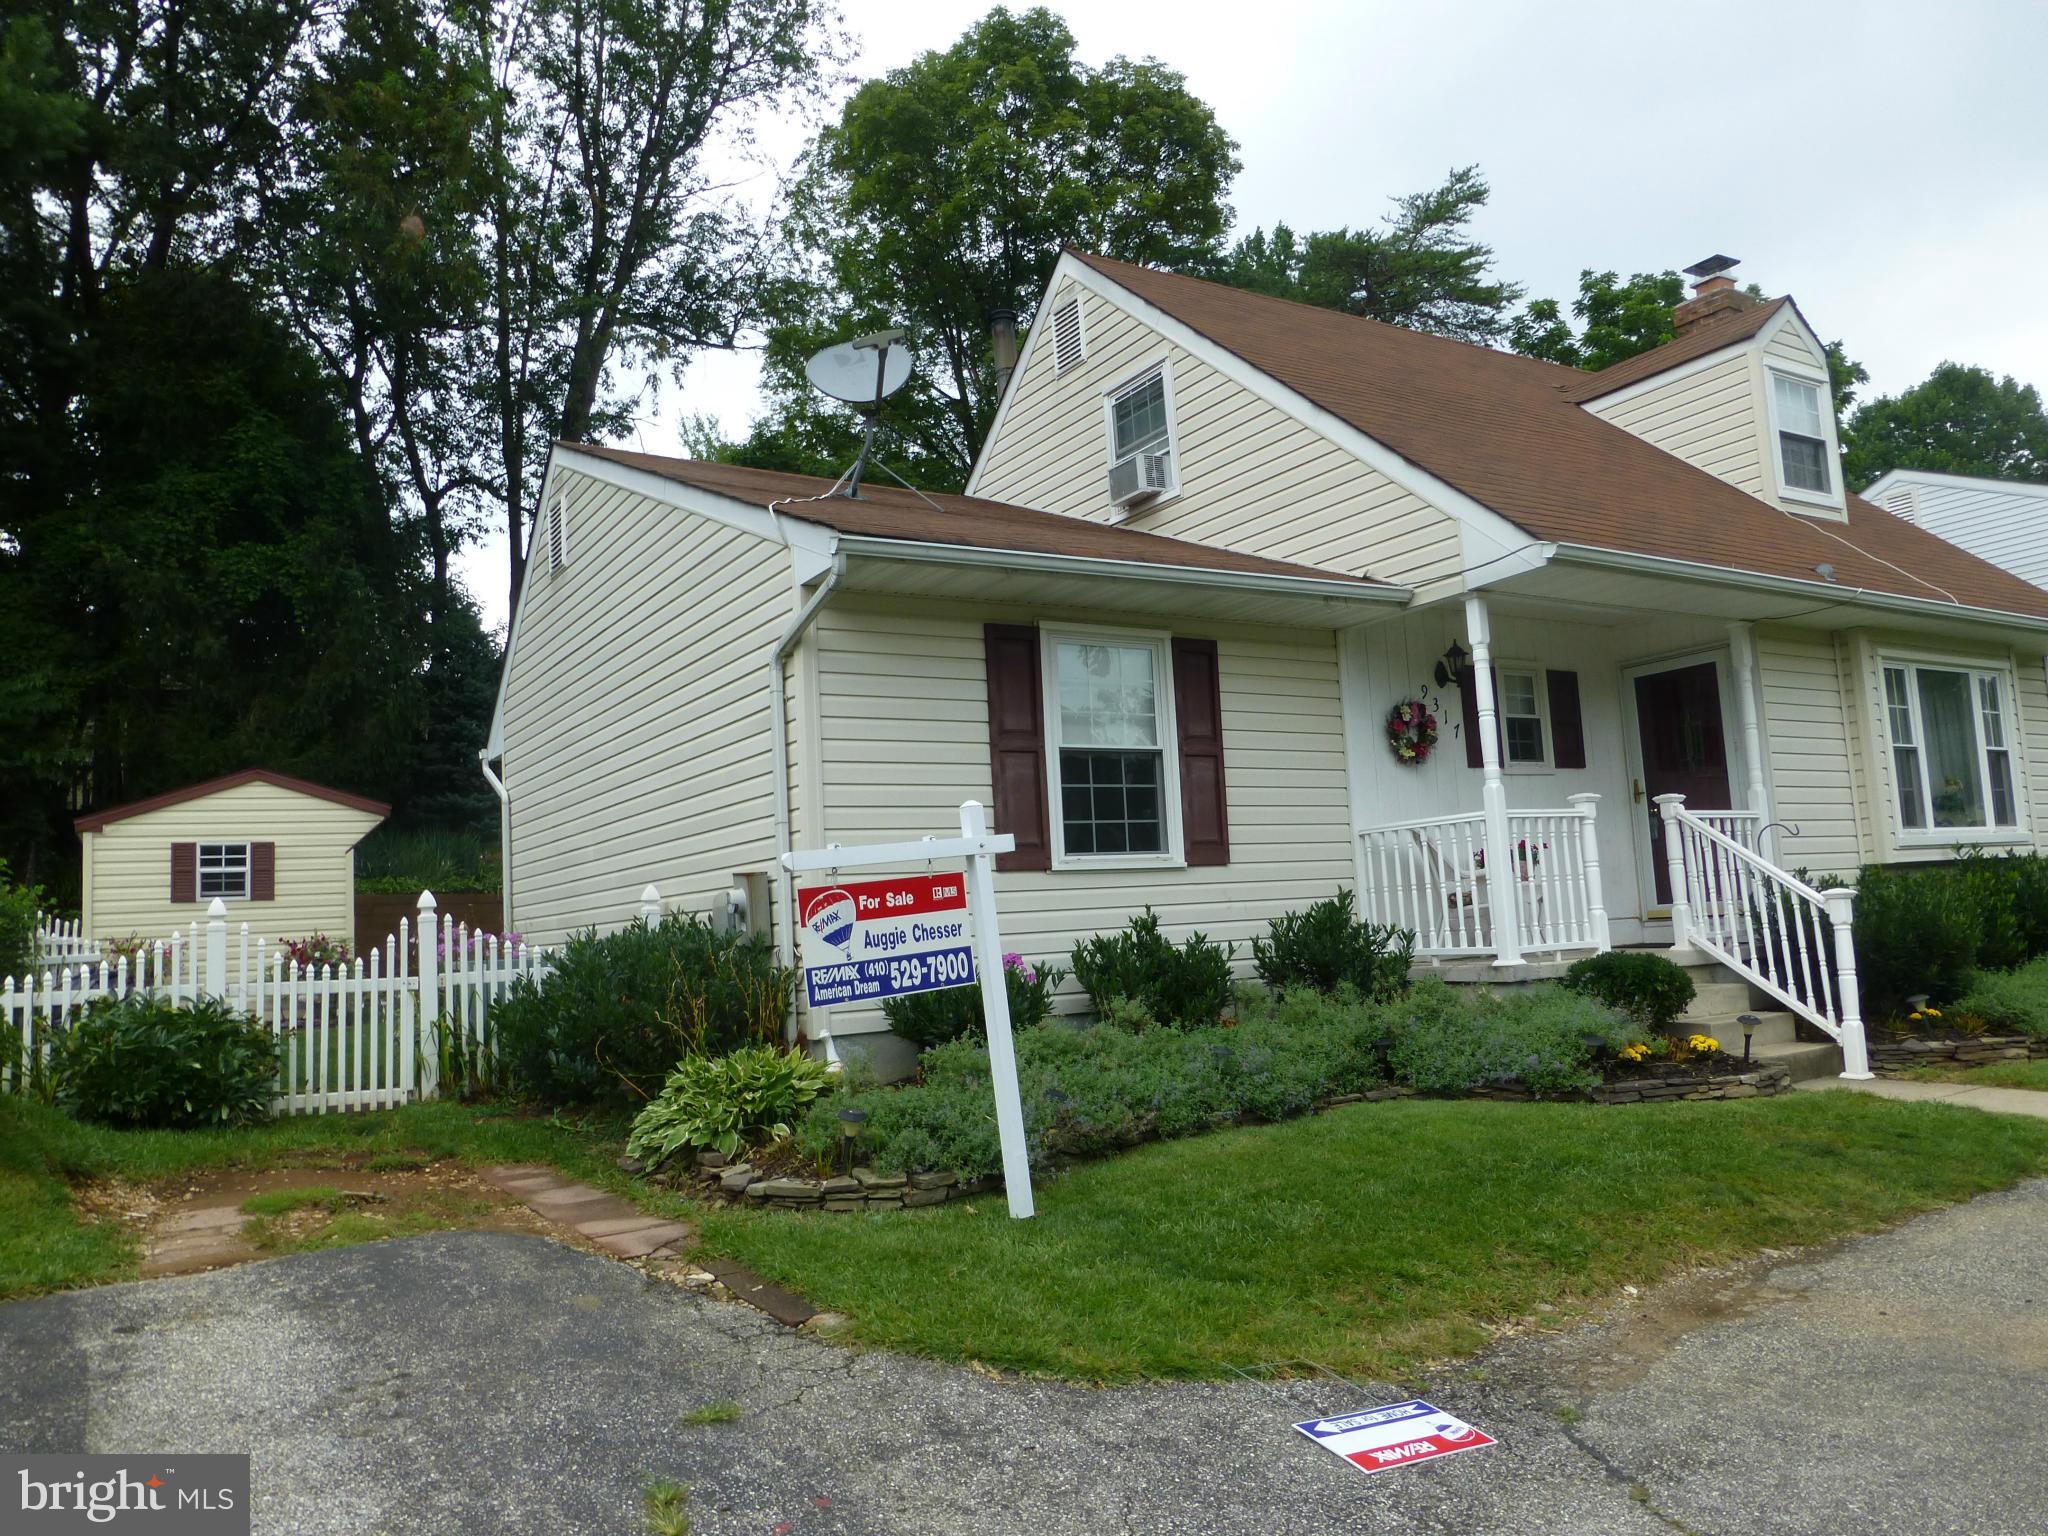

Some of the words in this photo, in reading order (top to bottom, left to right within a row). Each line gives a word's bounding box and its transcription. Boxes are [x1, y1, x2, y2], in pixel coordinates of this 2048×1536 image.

[859, 895, 880, 910] For
[886, 892, 914, 907] Sale
[812, 909, 842, 934] RE/MAX
[864, 926, 907, 950] Auggie
[912, 922, 963, 943] Chesser
[811, 963, 861, 985] RE/MAX
[864, 960, 889, 978] (410)
[890, 951, 969, 990] 529-7900
[814, 983, 852, 1001] American
[854, 980, 880, 996] Dream
[1330, 1418, 1361, 1430] SALE
[1378, 1408, 1411, 1420] HOME
[1368, 1440, 1438, 1464] RE/MAX
